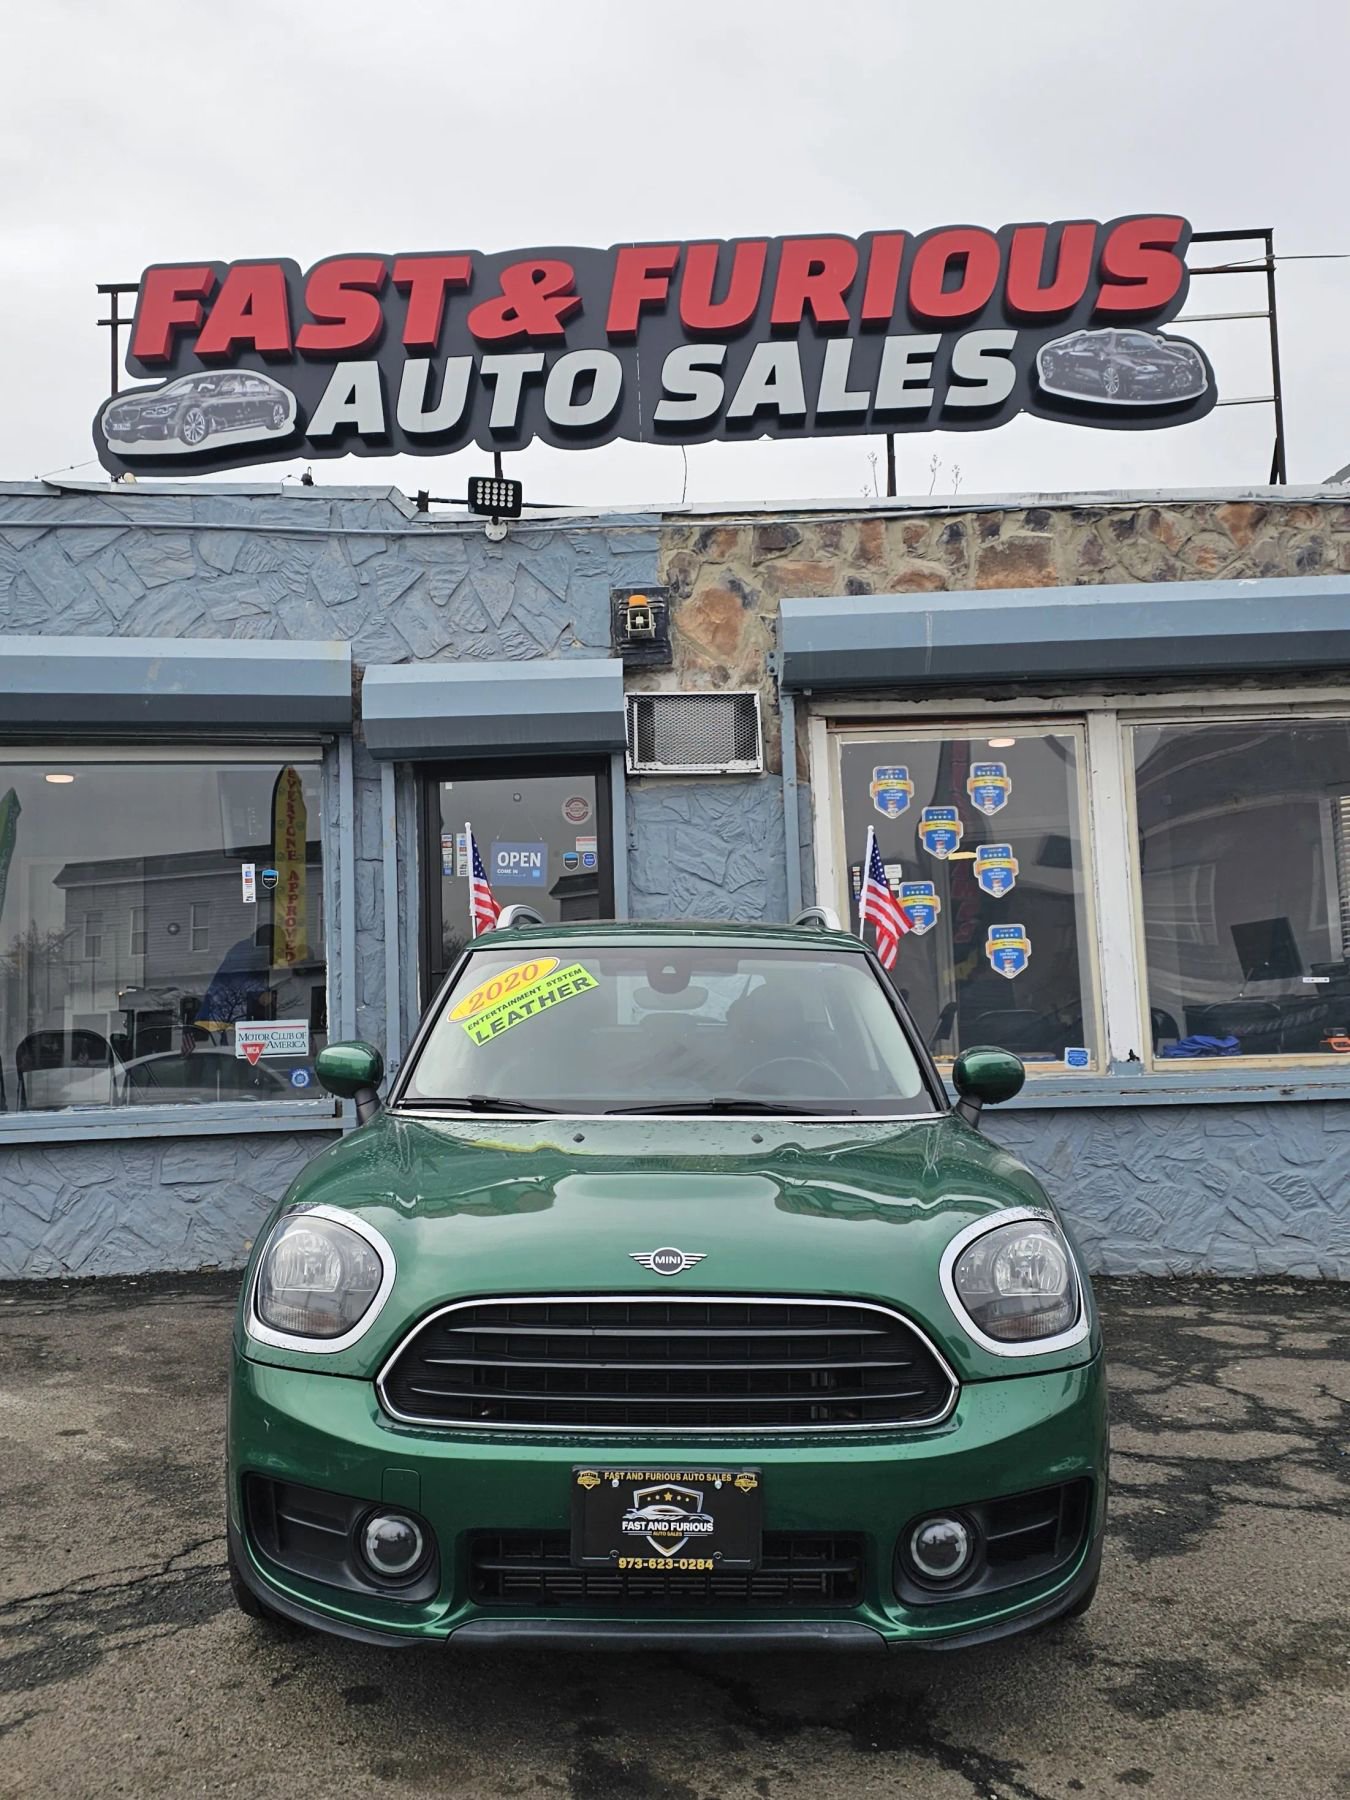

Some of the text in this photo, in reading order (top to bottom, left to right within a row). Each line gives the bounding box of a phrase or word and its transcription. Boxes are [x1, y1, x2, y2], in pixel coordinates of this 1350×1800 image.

[133, 216, 1185, 361] FAST & FURIOUS
[304, 330, 1019, 441] AUTO SALES
[284, 767, 300, 961] EVERYONE APPROVED
[497, 851, 541, 867] OPEN
[469, 963, 539, 1013] 2020
[467, 968, 582, 1031] ENTERTAINMENT SYSTEM
[475, 966, 592, 1044] LEATHER
[238, 1031, 307, 1042] MOTOR CLUB OF
[265, 1040, 306, 1049] AMERICA
[655, 1255, 681, 1264] MINI
[604, 1472, 732, 1482] FAST AND FURIOUS AUTO SALES
[622, 1521, 714, 1532] FAST AND FURIOUS
[618, 1557, 714, 1570] 973-623-0284
